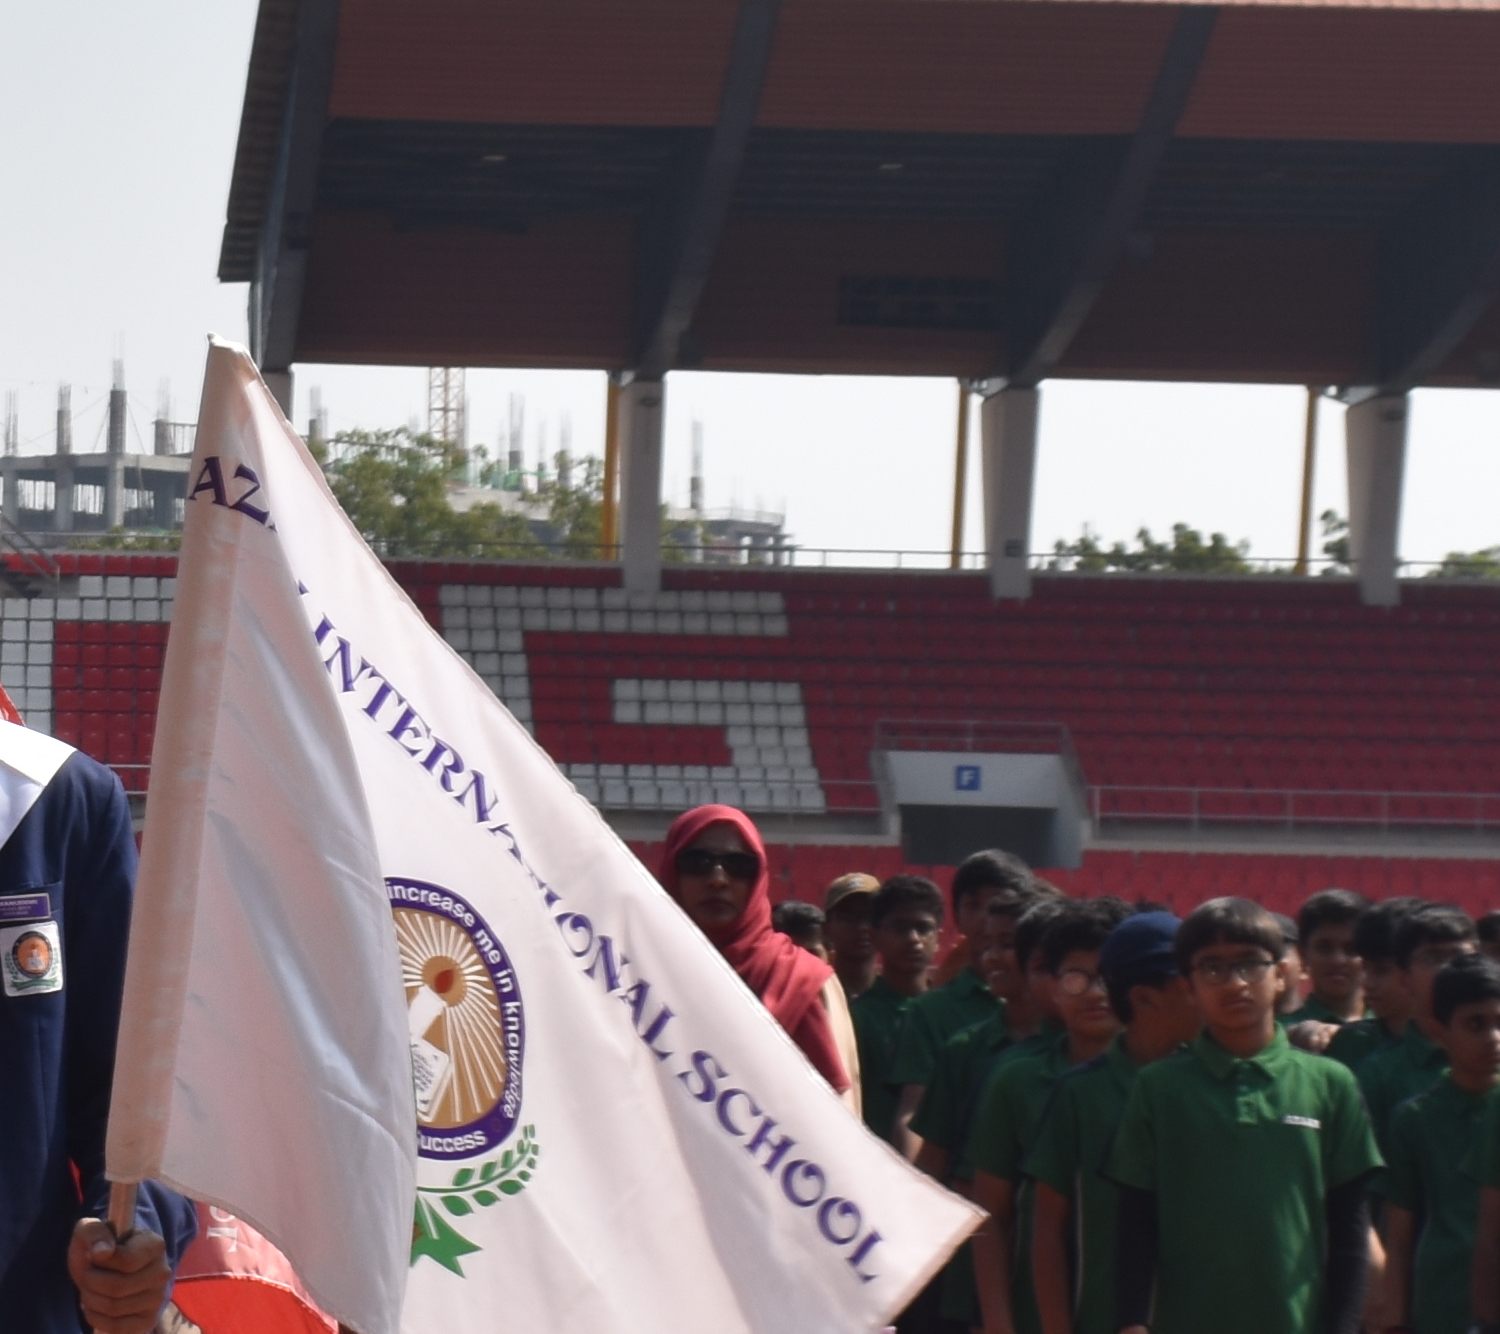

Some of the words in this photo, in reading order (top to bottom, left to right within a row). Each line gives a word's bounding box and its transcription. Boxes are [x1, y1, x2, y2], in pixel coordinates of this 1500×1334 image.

[962, 769, 975, 788] F
[385, 880, 476, 928] increase
[314, 612, 676, 1061] INTERNONAL
[677, 1049, 885, 1284] SCHOOL
[474, 927, 502, 965] me
[494, 968, 514, 994] in
[502, 1000, 523, 1119] knowledge
[417, 1130, 488, 1153] uccess
